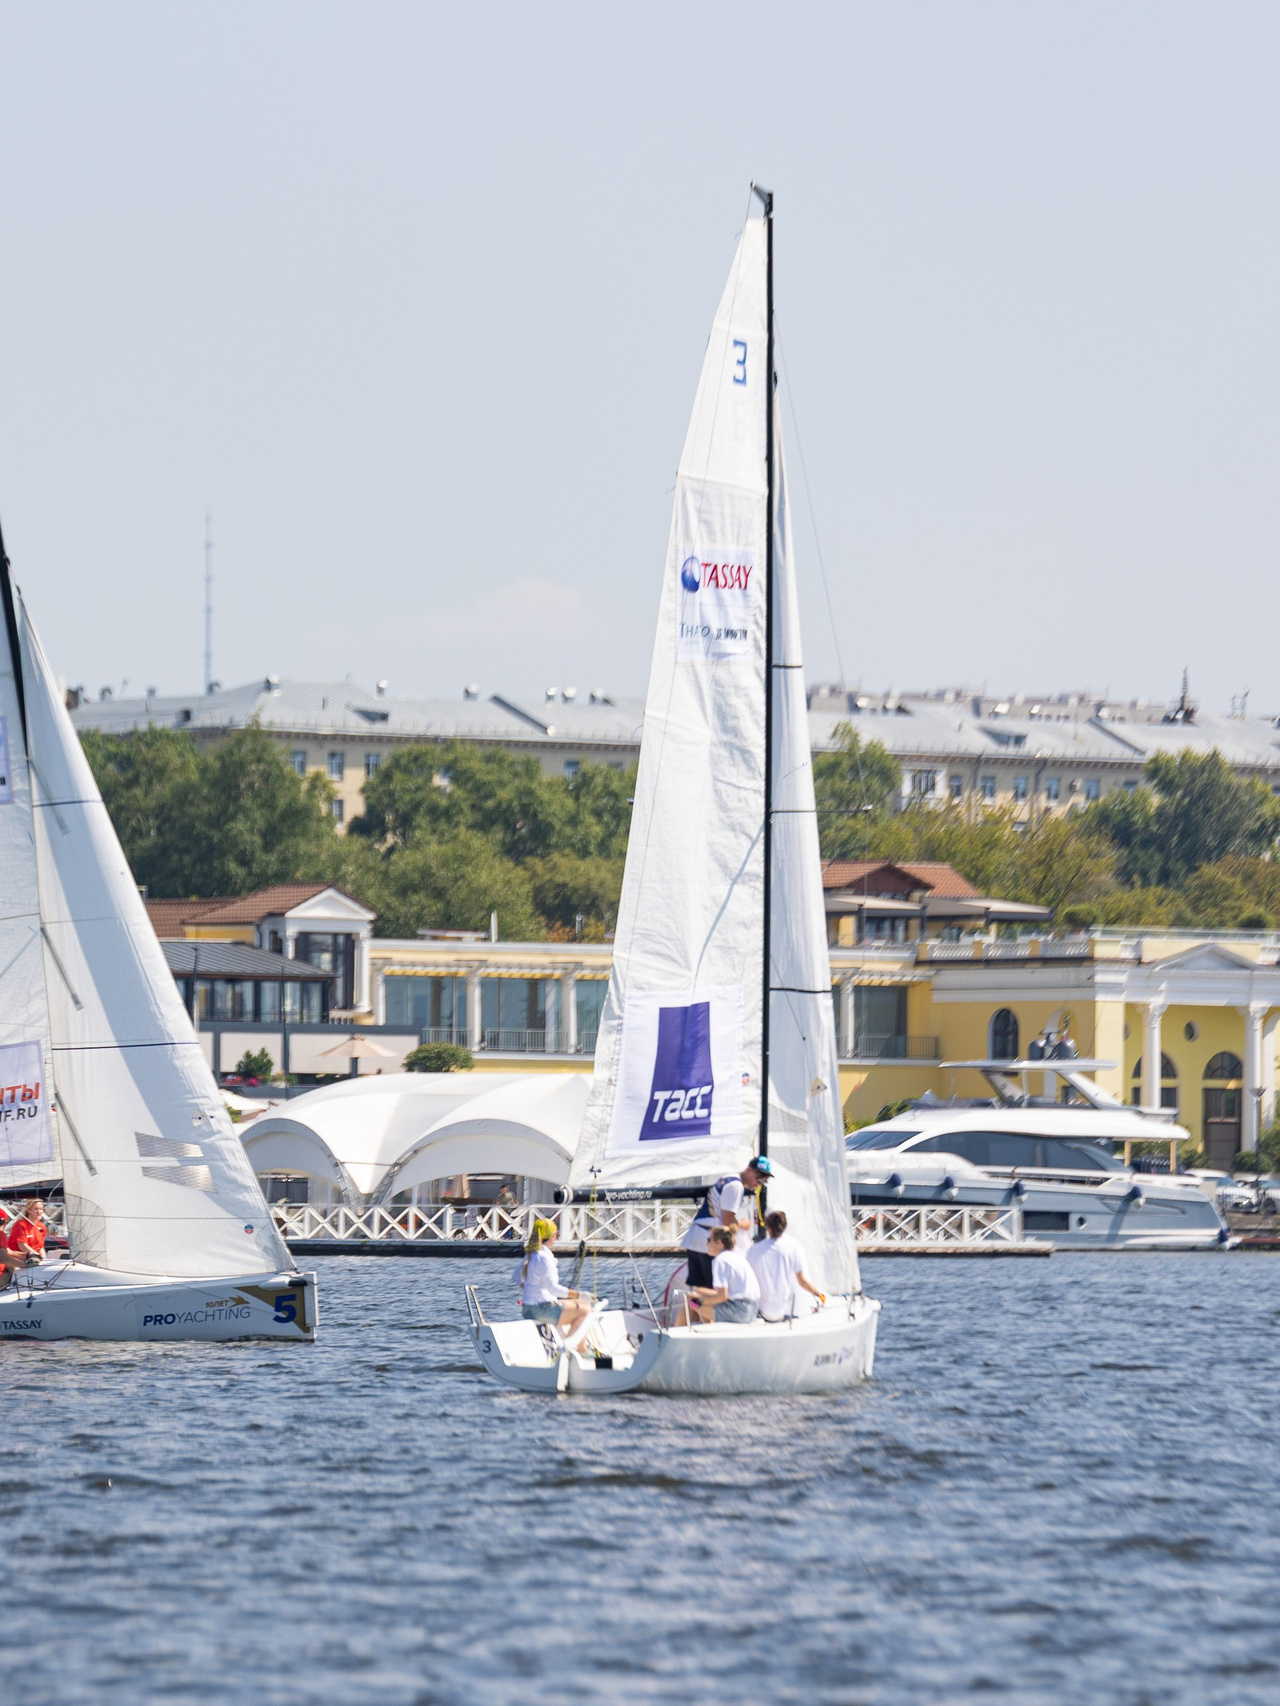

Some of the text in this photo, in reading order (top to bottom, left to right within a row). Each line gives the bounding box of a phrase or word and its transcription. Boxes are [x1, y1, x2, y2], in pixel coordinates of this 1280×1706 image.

[732, 340, 748, 386] 3
[701, 562, 753, 590] TASSAY
[143, 1306, 252, 1327] PROYACHTING
[272, 1294, 297, 1324] 5
[1, 1320, 42, 1330] TASSAY
[482, 1340, 492, 1354] 3
